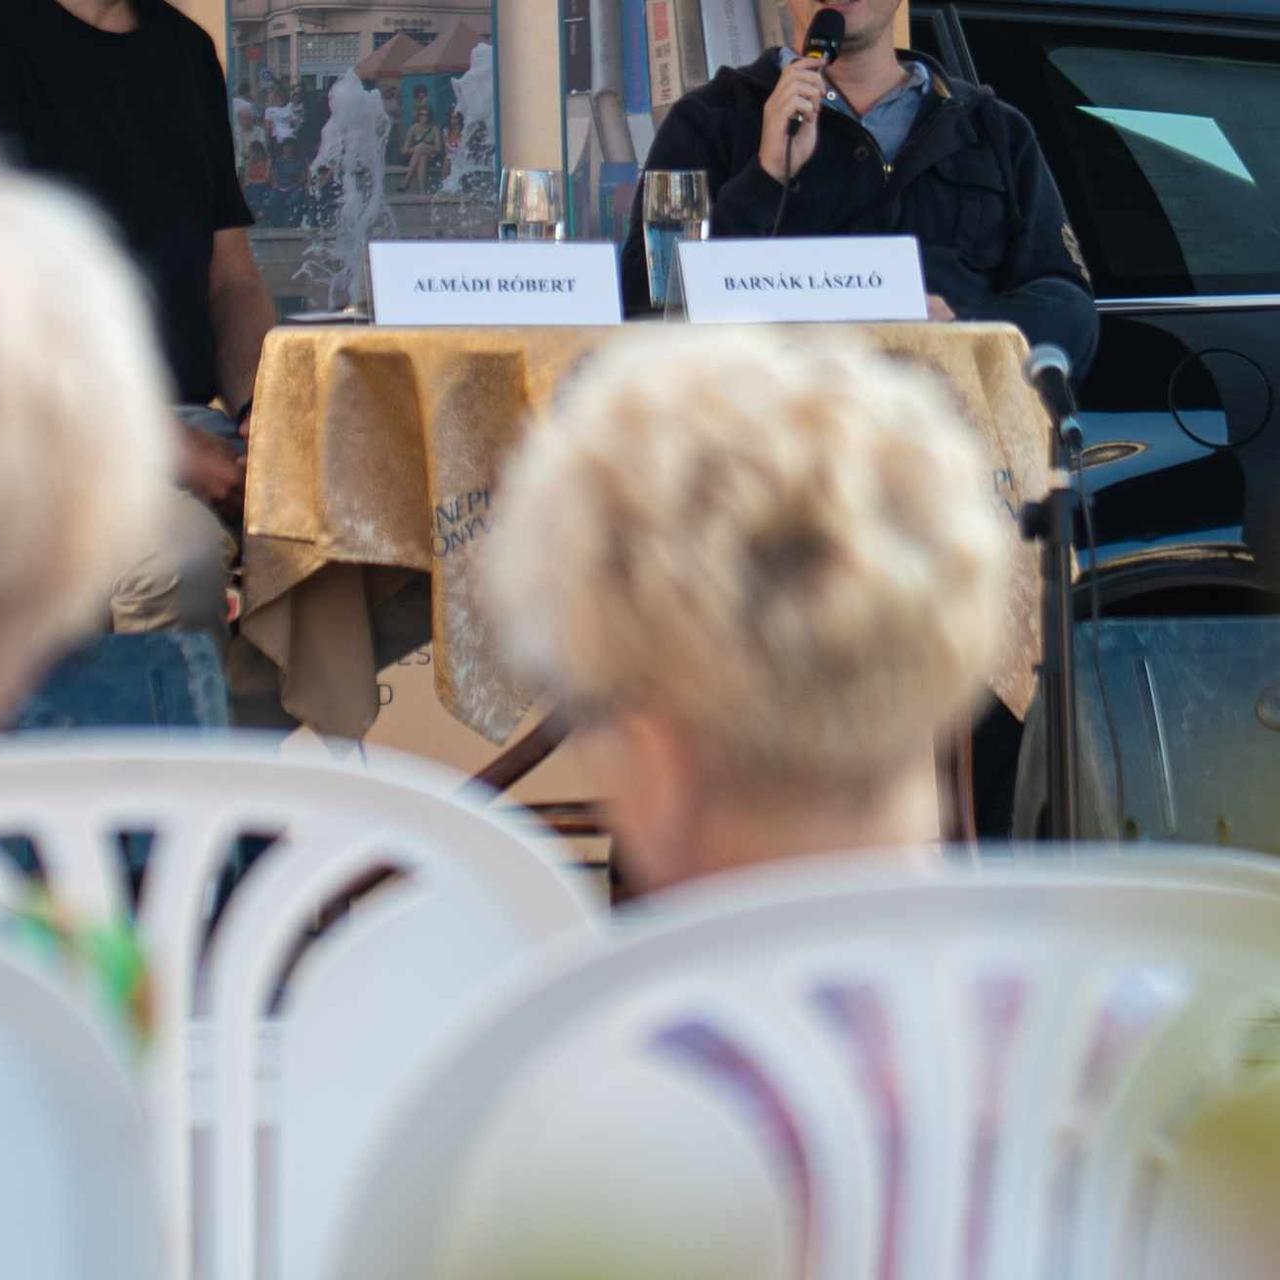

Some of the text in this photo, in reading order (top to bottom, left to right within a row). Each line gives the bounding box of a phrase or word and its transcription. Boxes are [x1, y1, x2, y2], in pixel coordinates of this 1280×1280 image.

[414, 272, 577, 293] ALMÁDI RÓBERT
[724, 270, 883, 290] BARNÁK LÁSZLÓ
